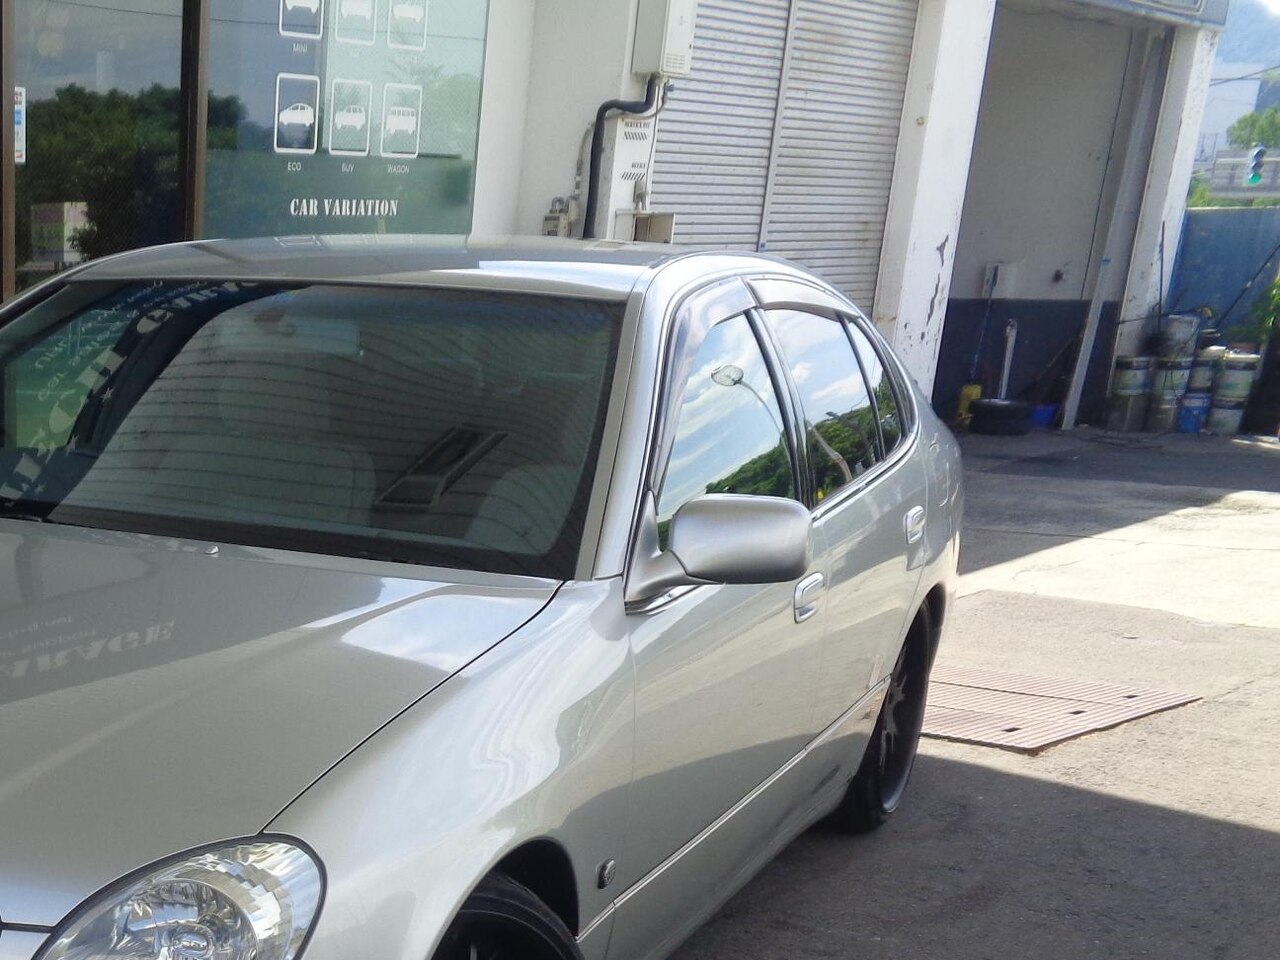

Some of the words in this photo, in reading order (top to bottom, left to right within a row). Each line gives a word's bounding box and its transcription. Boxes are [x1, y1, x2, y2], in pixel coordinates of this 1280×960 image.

[287, 162, 302, 171] ECO
[387, 164, 410, 173] WAGON
[290, 198, 318, 216] CAR
[324, 198, 399, 217] VARIATION
